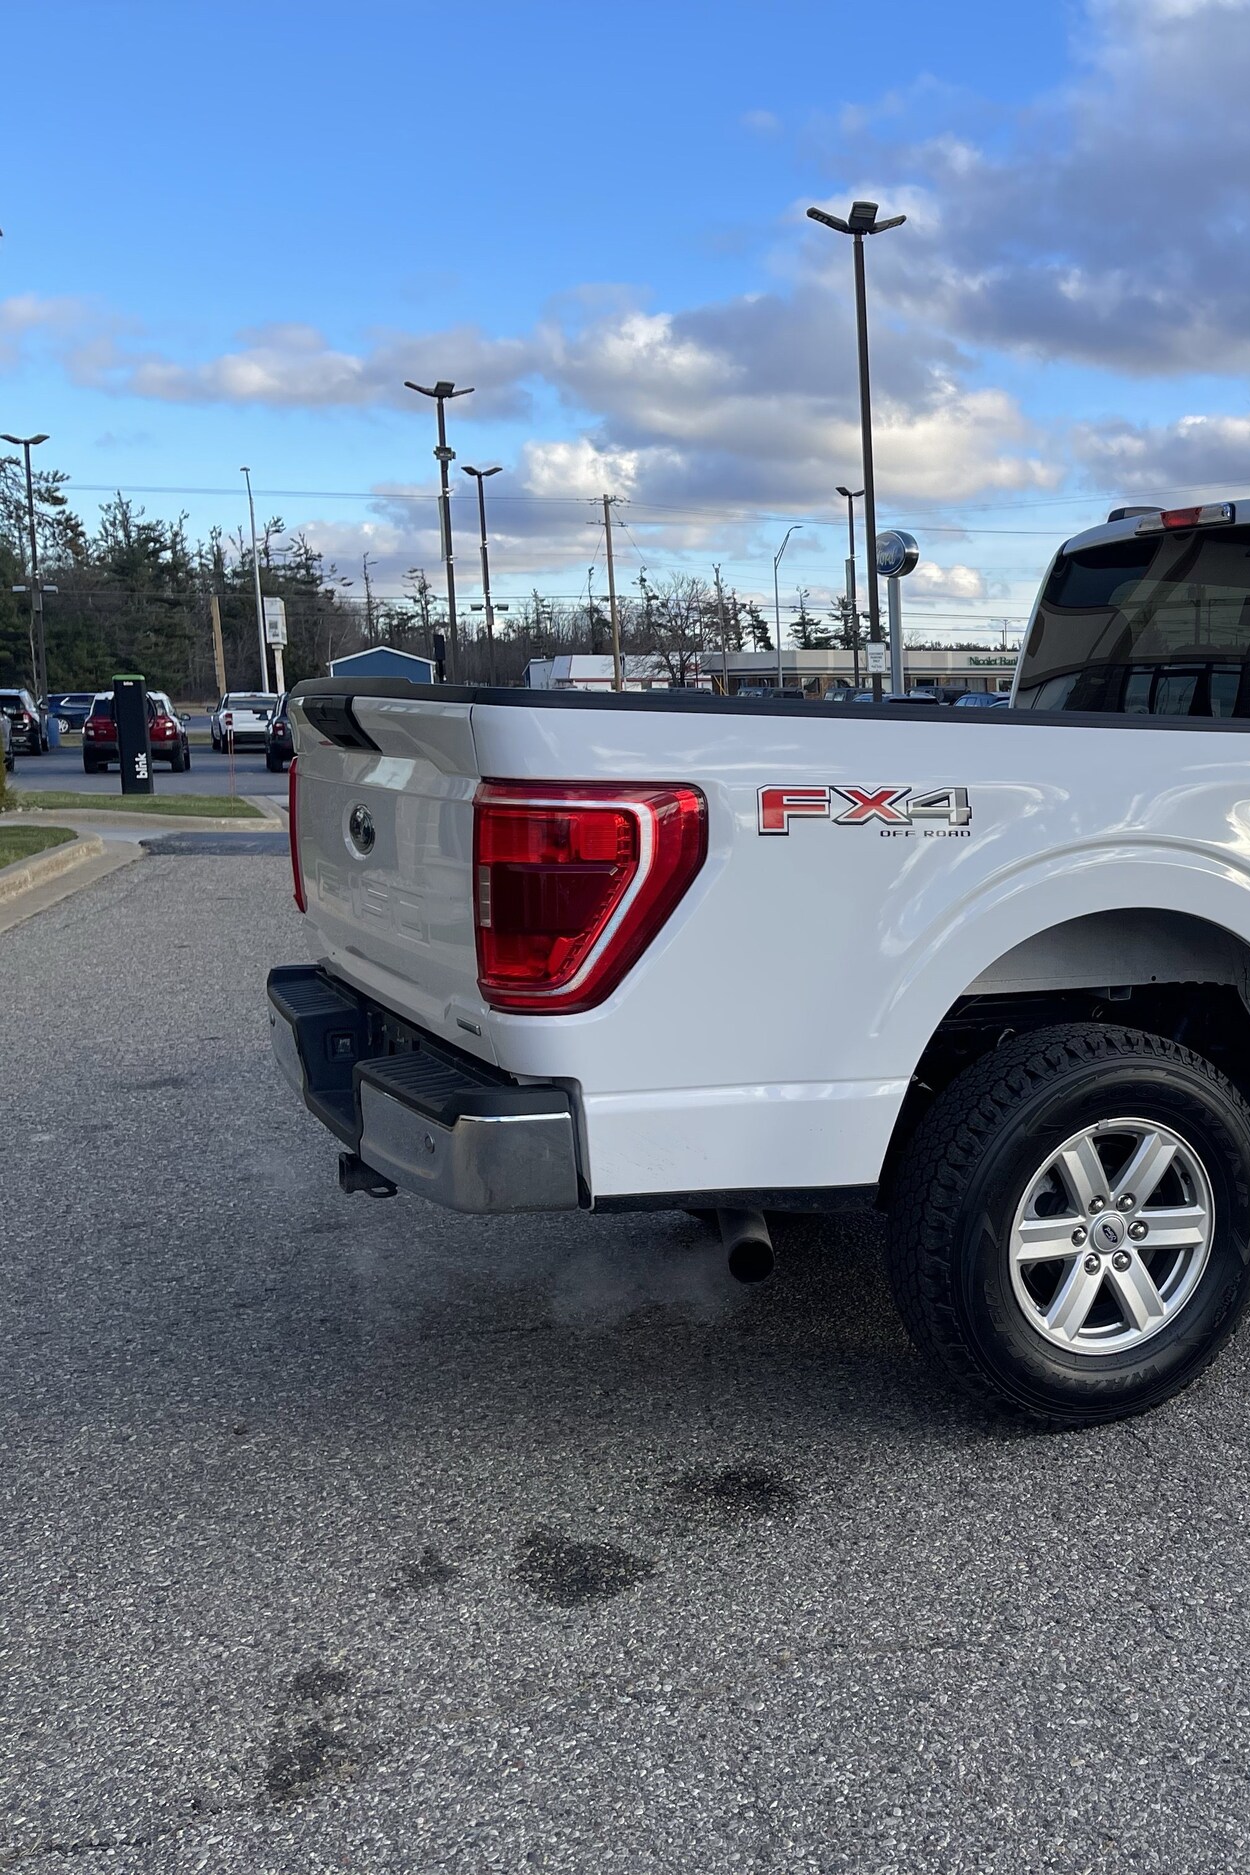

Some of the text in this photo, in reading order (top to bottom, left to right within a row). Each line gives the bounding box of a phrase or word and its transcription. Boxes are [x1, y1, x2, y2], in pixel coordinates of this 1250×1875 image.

[135, 752, 148, 779] blink
[757, 784, 973, 837] FX4
[880, 830, 971, 838] OFF ROAD
